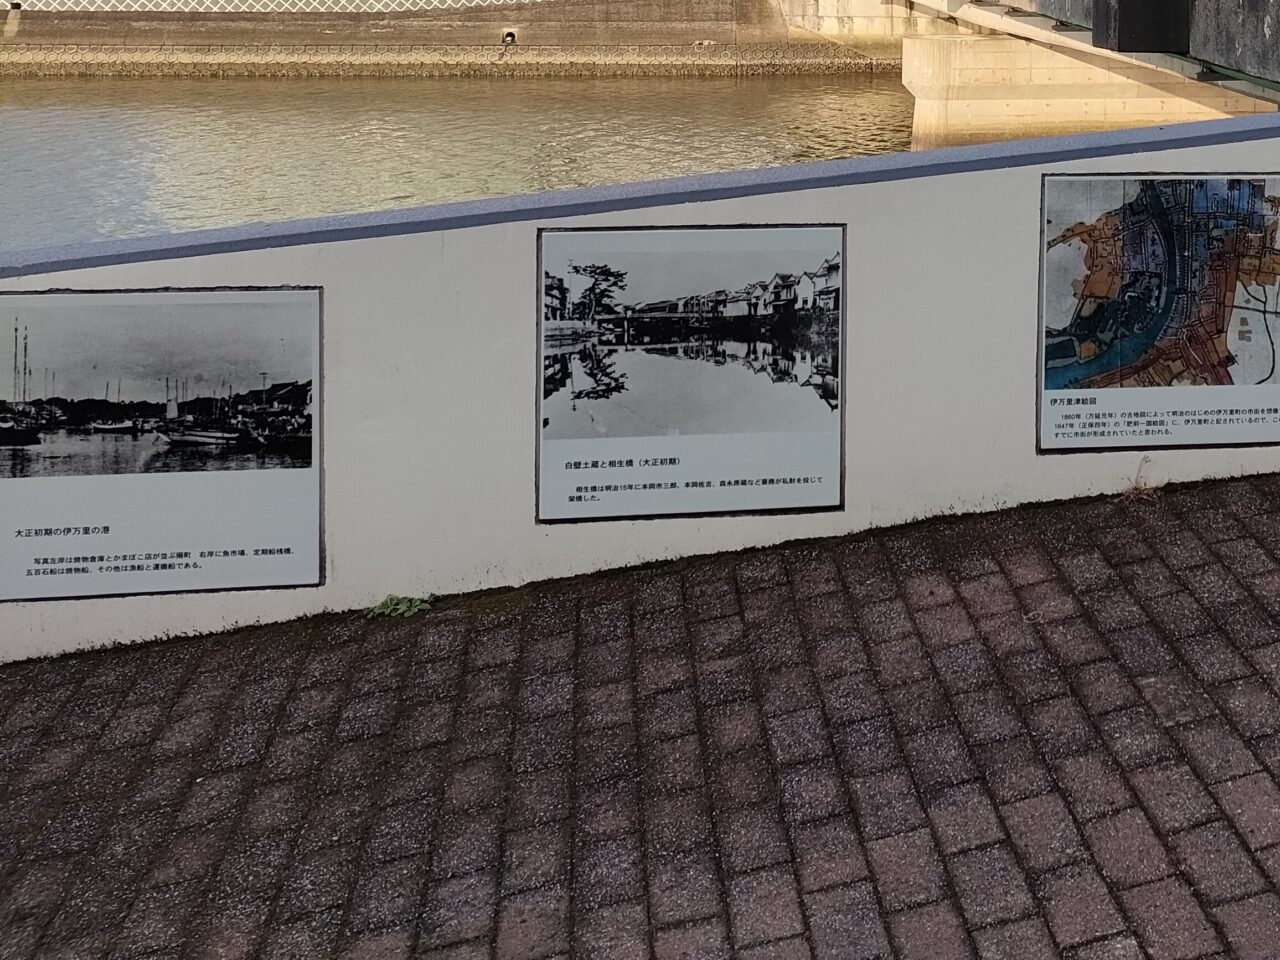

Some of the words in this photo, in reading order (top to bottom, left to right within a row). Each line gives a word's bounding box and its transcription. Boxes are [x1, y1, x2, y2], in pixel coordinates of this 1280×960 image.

[1050, 397, 1097, 406] 伊万里津絵図
[1054, 429, 1173, 439] すでに市街が形成されていたと思われる。
[565, 457, 681, 470] 白壁土蔵と相生橋（大正初期）
[568, 495, 601, 503] 架橋した。
[15, 526, 110, 538] 大正初期の伊万里の港
